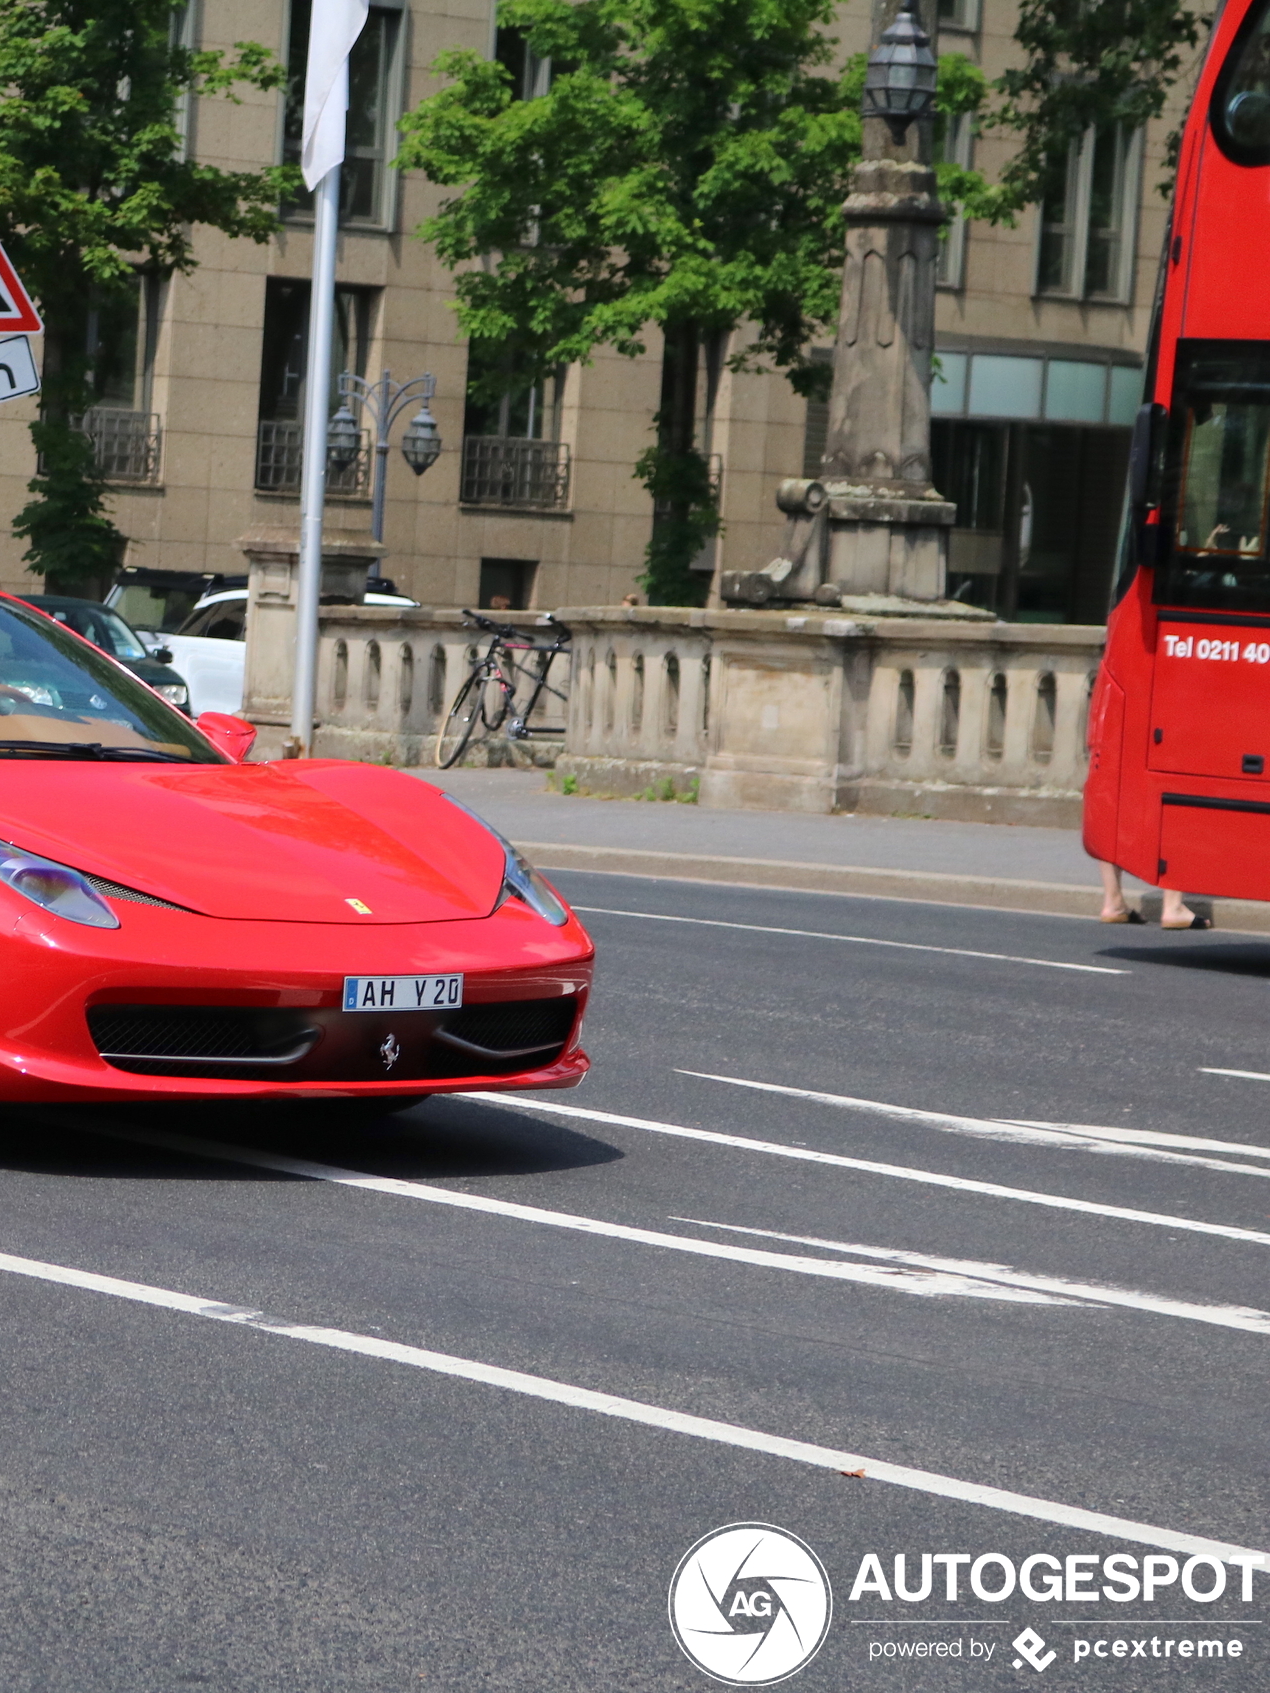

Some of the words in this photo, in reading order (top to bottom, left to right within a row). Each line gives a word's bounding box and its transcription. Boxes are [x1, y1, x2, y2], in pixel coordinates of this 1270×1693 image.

[1164, 635, 1194, 658] Tel
[1197, 639, 1239, 662] 0211
[1243, 643, 1270, 664] 40
[362, 981, 395, 1006] AH
[415, 980, 427, 1006] Y
[434, 979, 459, 1004] 20
